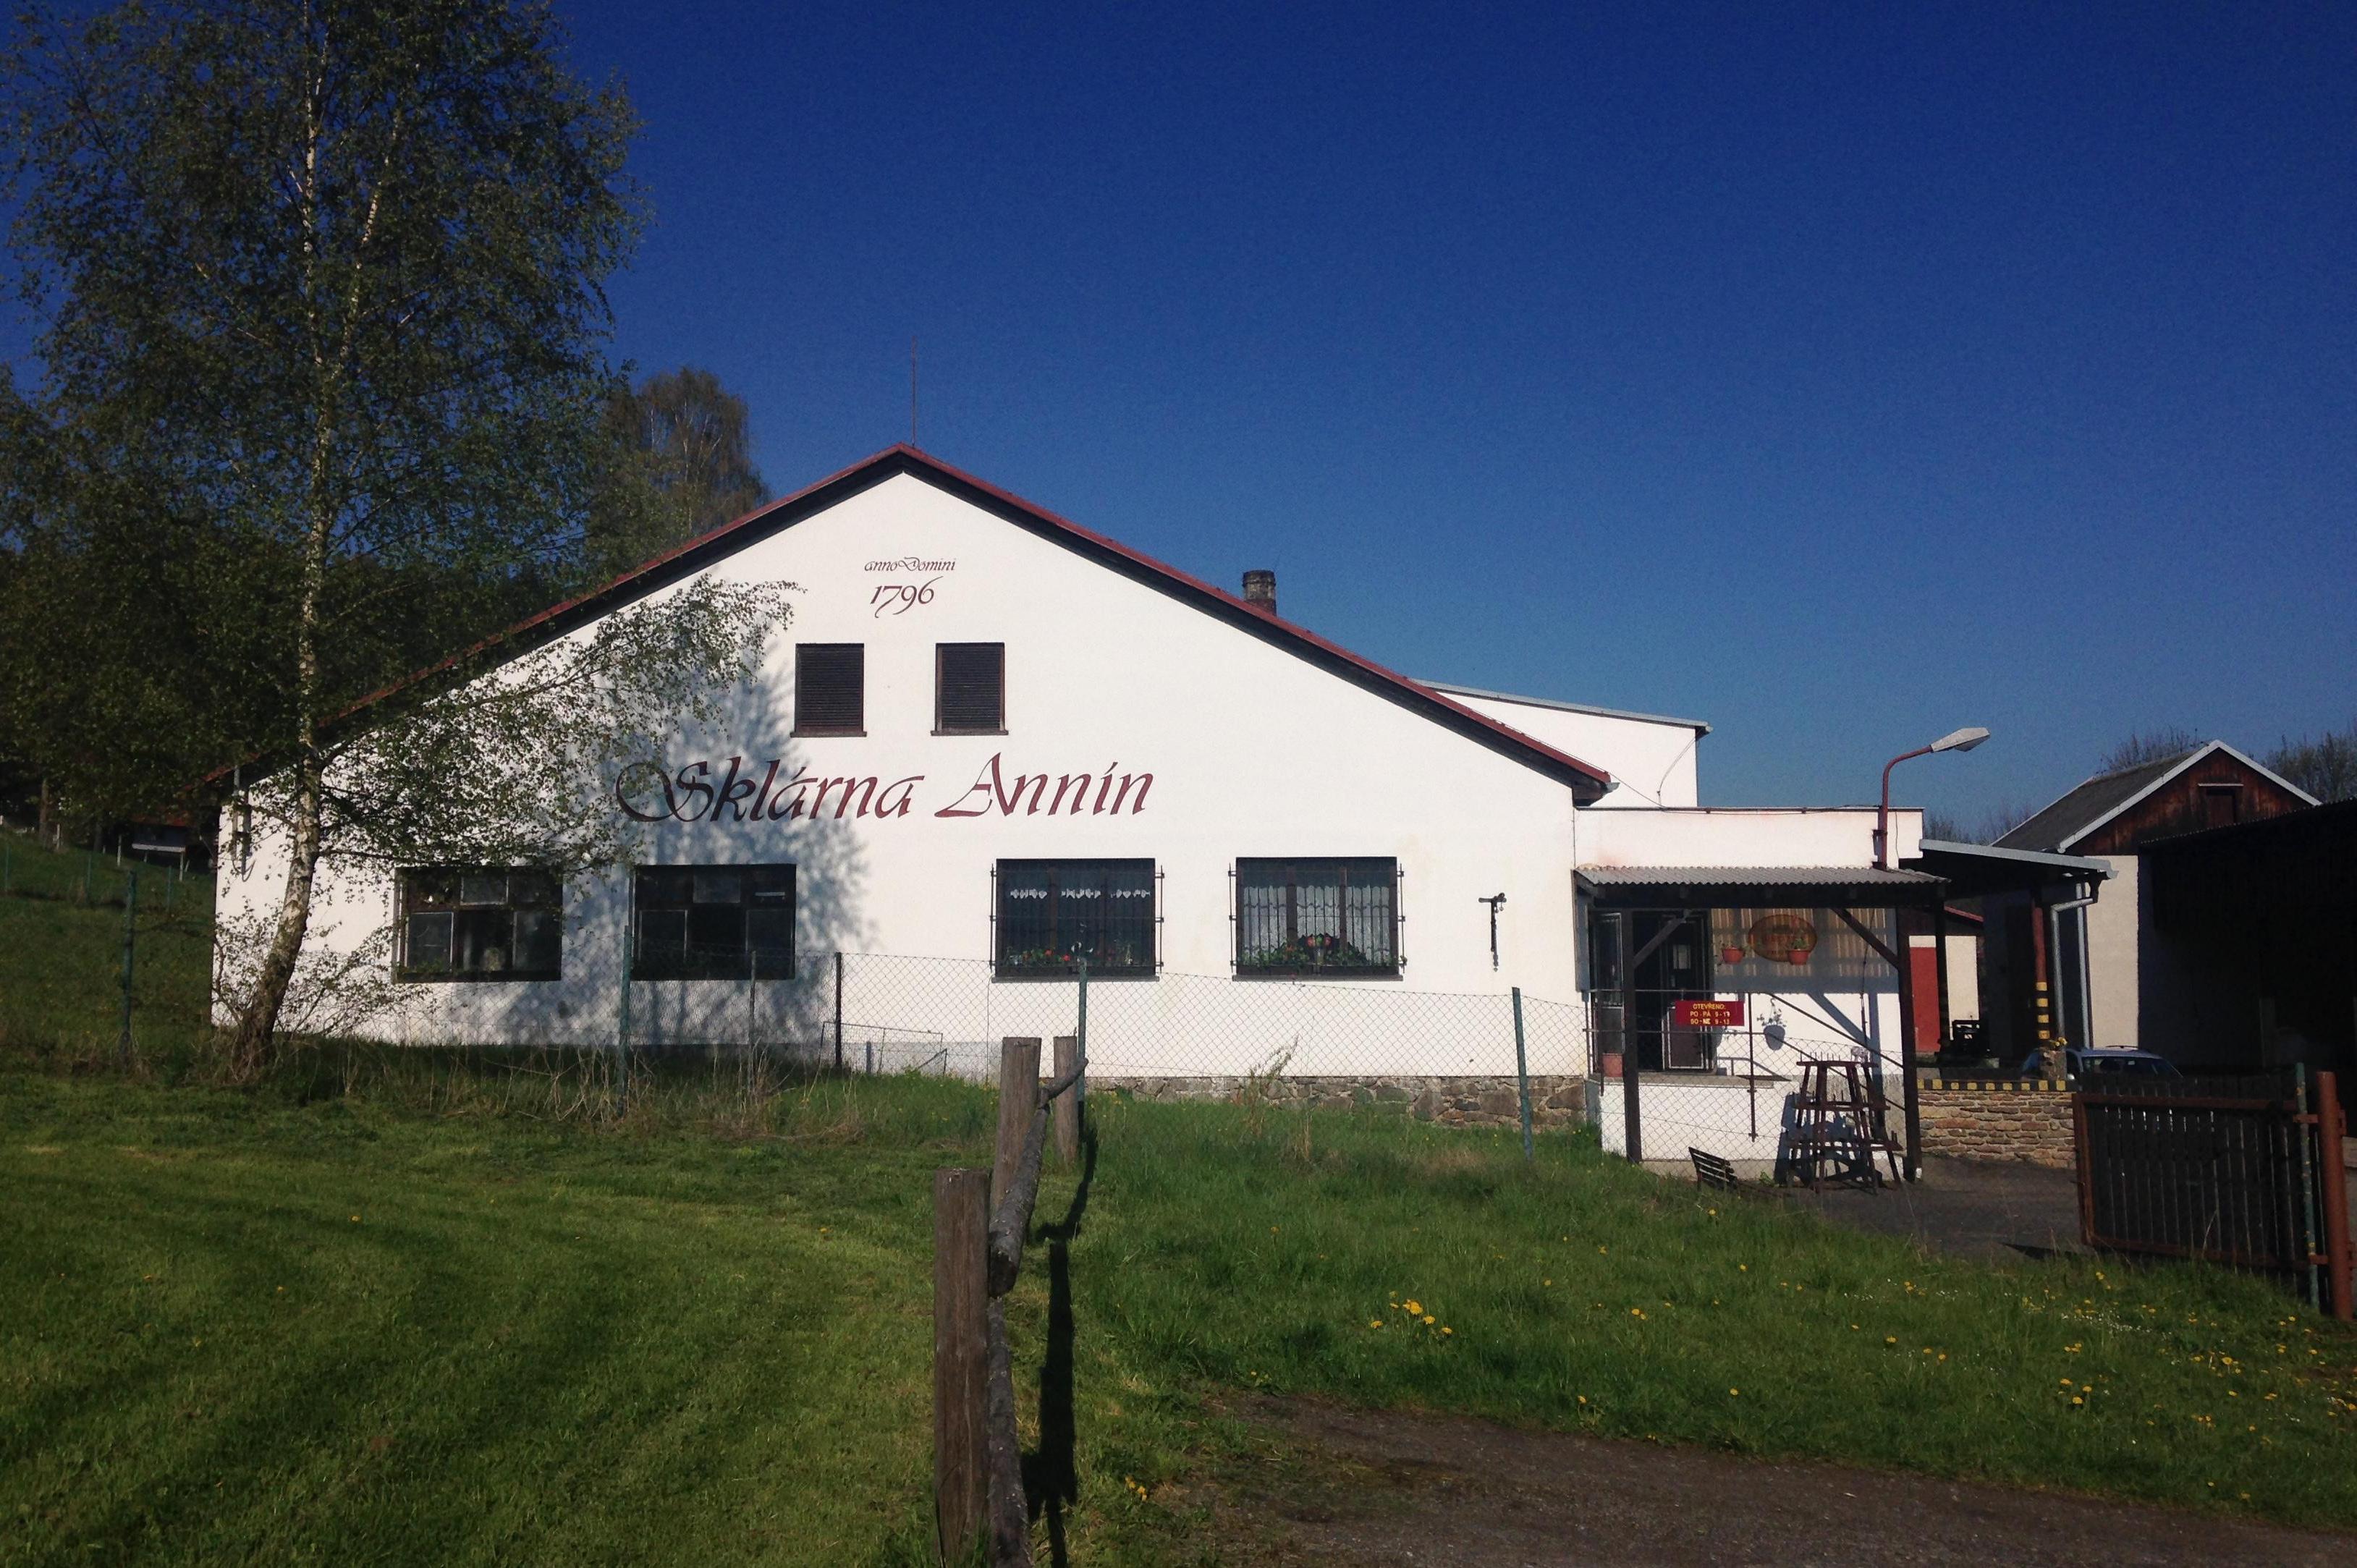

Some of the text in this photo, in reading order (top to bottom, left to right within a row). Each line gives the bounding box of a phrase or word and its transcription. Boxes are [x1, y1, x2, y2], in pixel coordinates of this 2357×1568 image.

[870, 576, 944, 618] 1796
[616, 752, 1154, 823] Sklárna Annín
